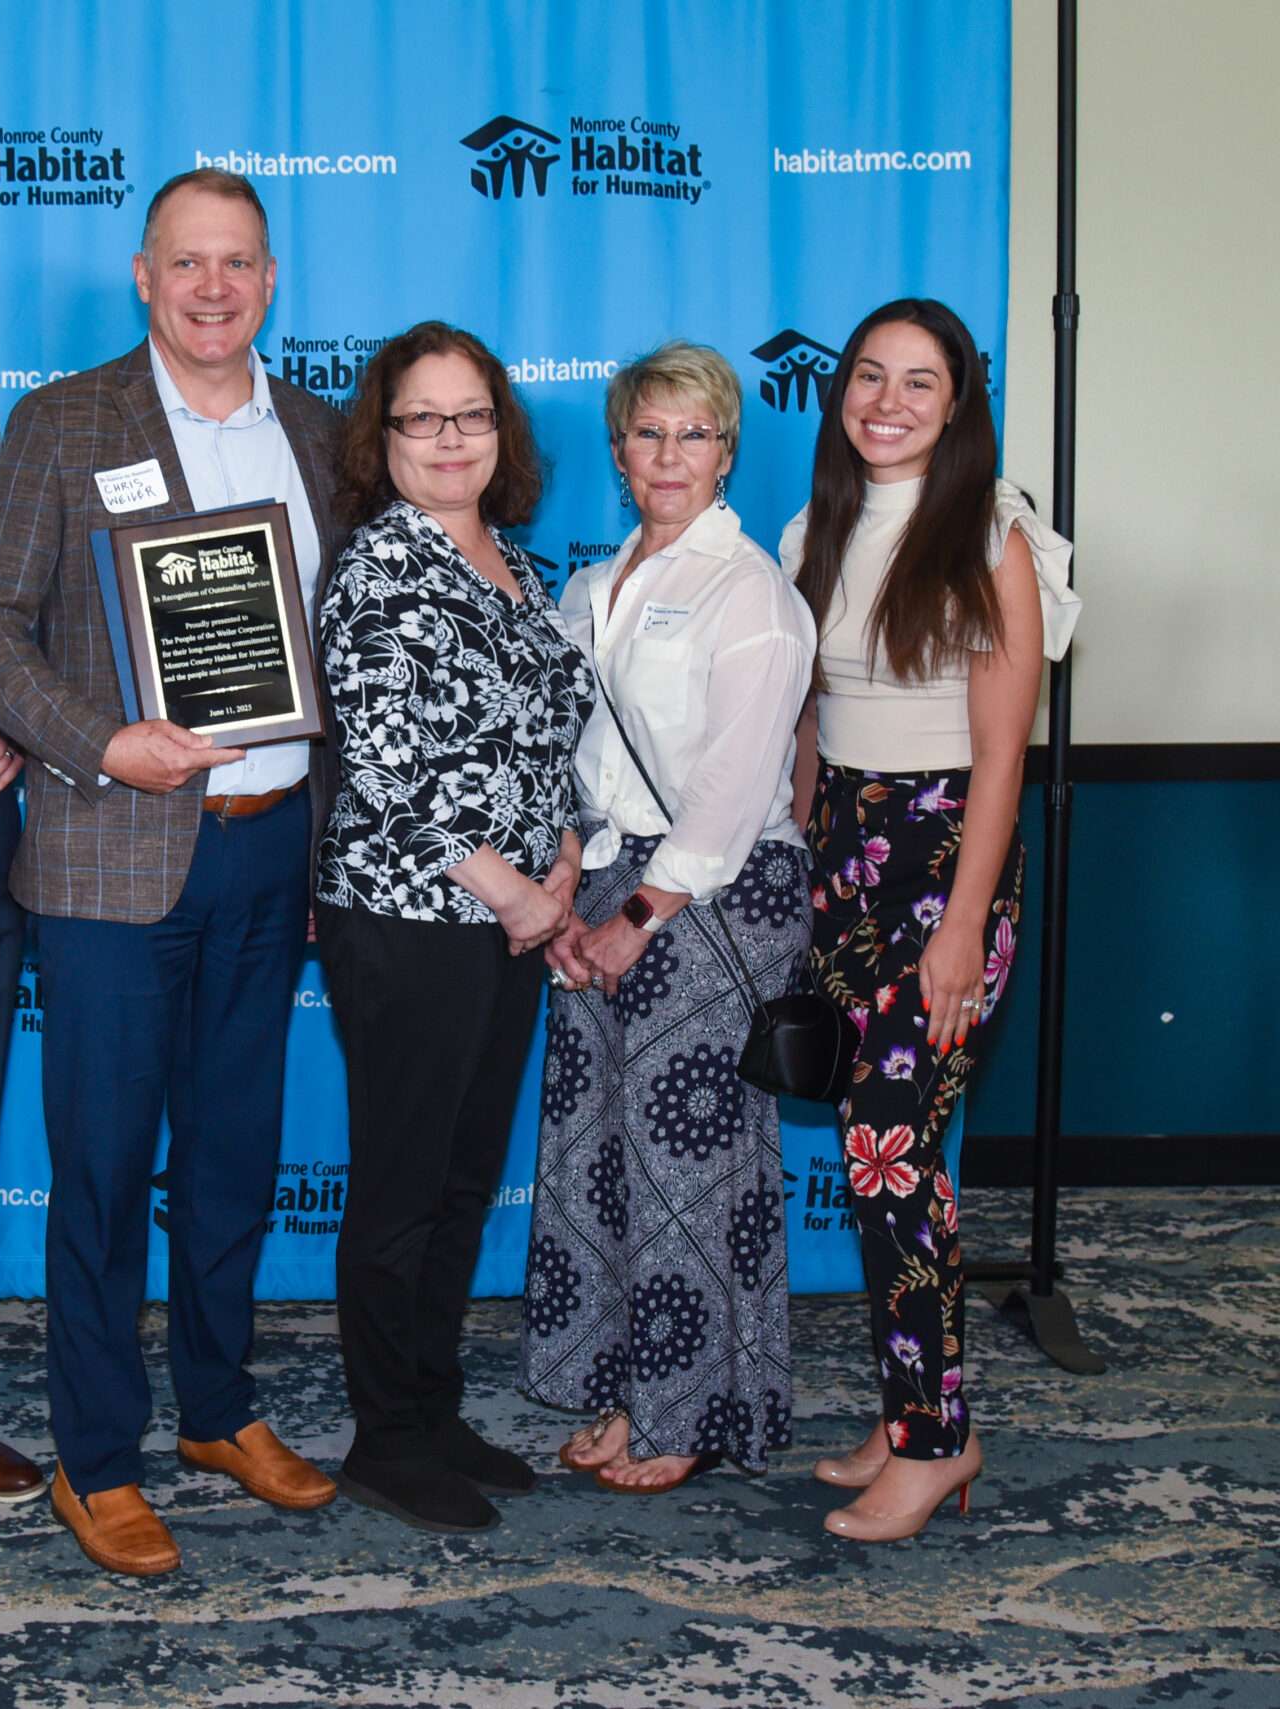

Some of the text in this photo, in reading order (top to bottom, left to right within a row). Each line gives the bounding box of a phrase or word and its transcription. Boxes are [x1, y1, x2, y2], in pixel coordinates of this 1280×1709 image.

[50, 126, 103, 147] County
[570, 116, 680, 141] Monroe County
[571, 135, 703, 177] Habitat
[774, 147, 971, 174] habitatmc.com
[572, 176, 599, 195] for
[282, 336, 339, 353] Monroe
[282, 355, 365, 390] Habi
[103, 478, 144, 494] CHRIS
[199, 551, 255, 571] Habitat
[202, 572, 214, 580] for
[161, 591, 200, 602] Recognition
[200, 588, 208, 596] of
[208, 583, 246, 595] Outstanding
[246, 580, 270, 589] Service
[276, 1178, 344, 1212] abit
[803, 1212, 832, 1231] for
